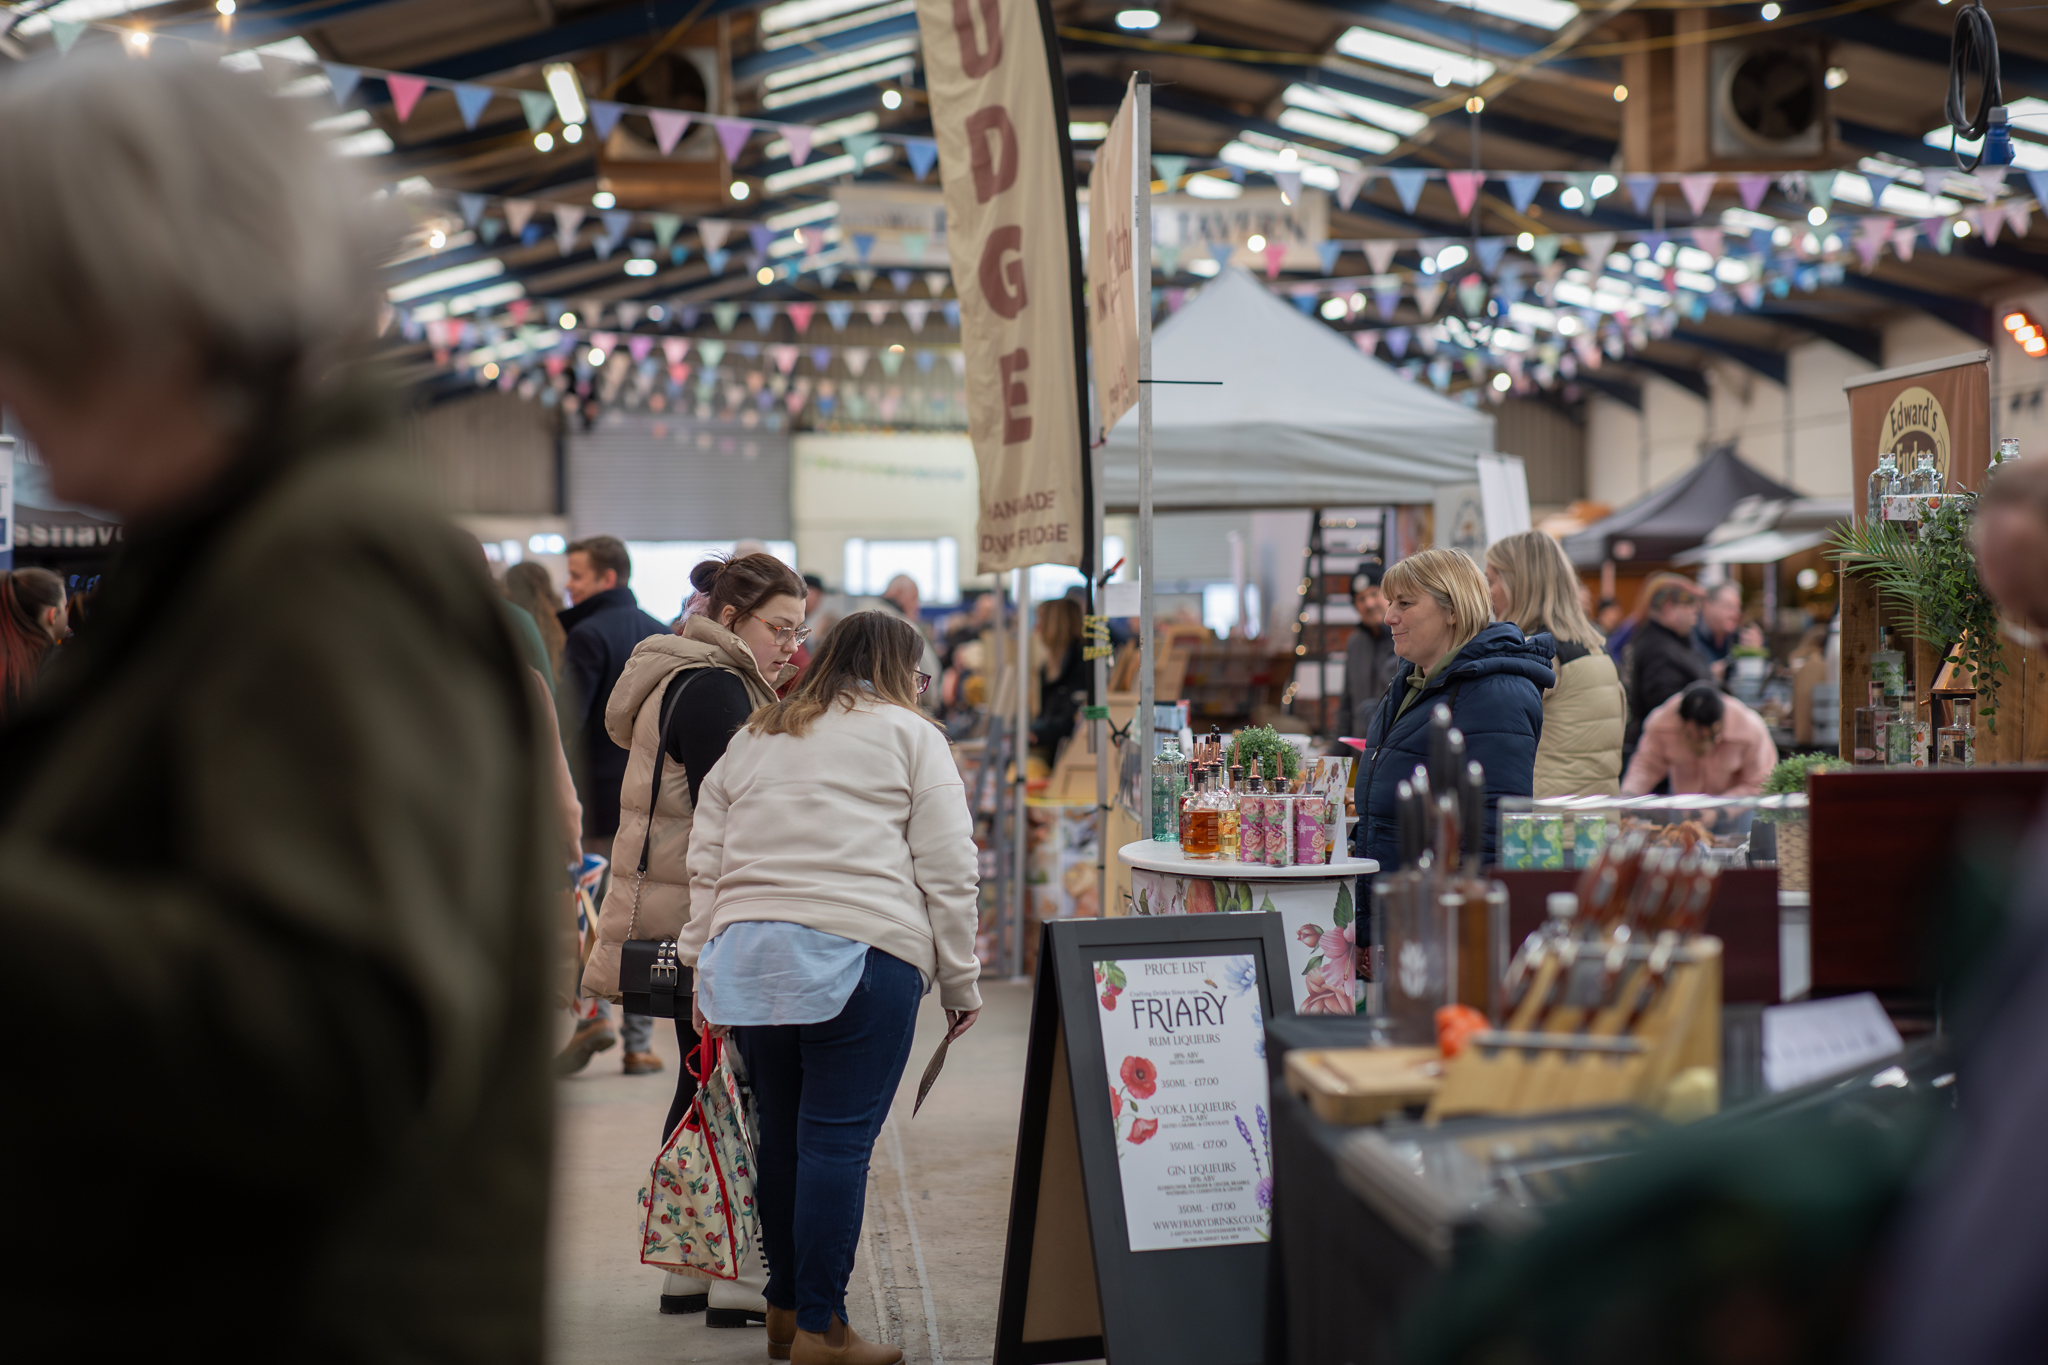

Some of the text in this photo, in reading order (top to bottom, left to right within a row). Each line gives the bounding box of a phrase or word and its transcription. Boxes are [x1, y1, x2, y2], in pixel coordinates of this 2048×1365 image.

[1890, 397, 1938, 439] Edward's
[1896, 440, 1932, 477] Fud
[1144, 961, 1206, 976] PRICE LIST
[1131, 991, 1228, 1034] FRIARY
[1148, 1033, 1221, 1047] RUM LIQUEURS
[1186, 1051, 1199, 1059] ABV
[1161, 1078, 1187, 1089] 350ML
[1194, 1076, 1219, 1087] £17.00
[1150, 1100, 1237, 1116] VODKA LIQUEURS
[1181, 1113, 1208, 1122] 22% ABV
[1169, 1141, 1195, 1152] 350ML
[1202, 1139, 1228, 1150] £17.00
[1167, 1162, 1237, 1176] GIN LIQUEURS
[1203, 1174, 1216, 1182] ABV
[1178, 1203, 1204, 1215] 350ML
[1211, 1201, 1236, 1212] £17.00
